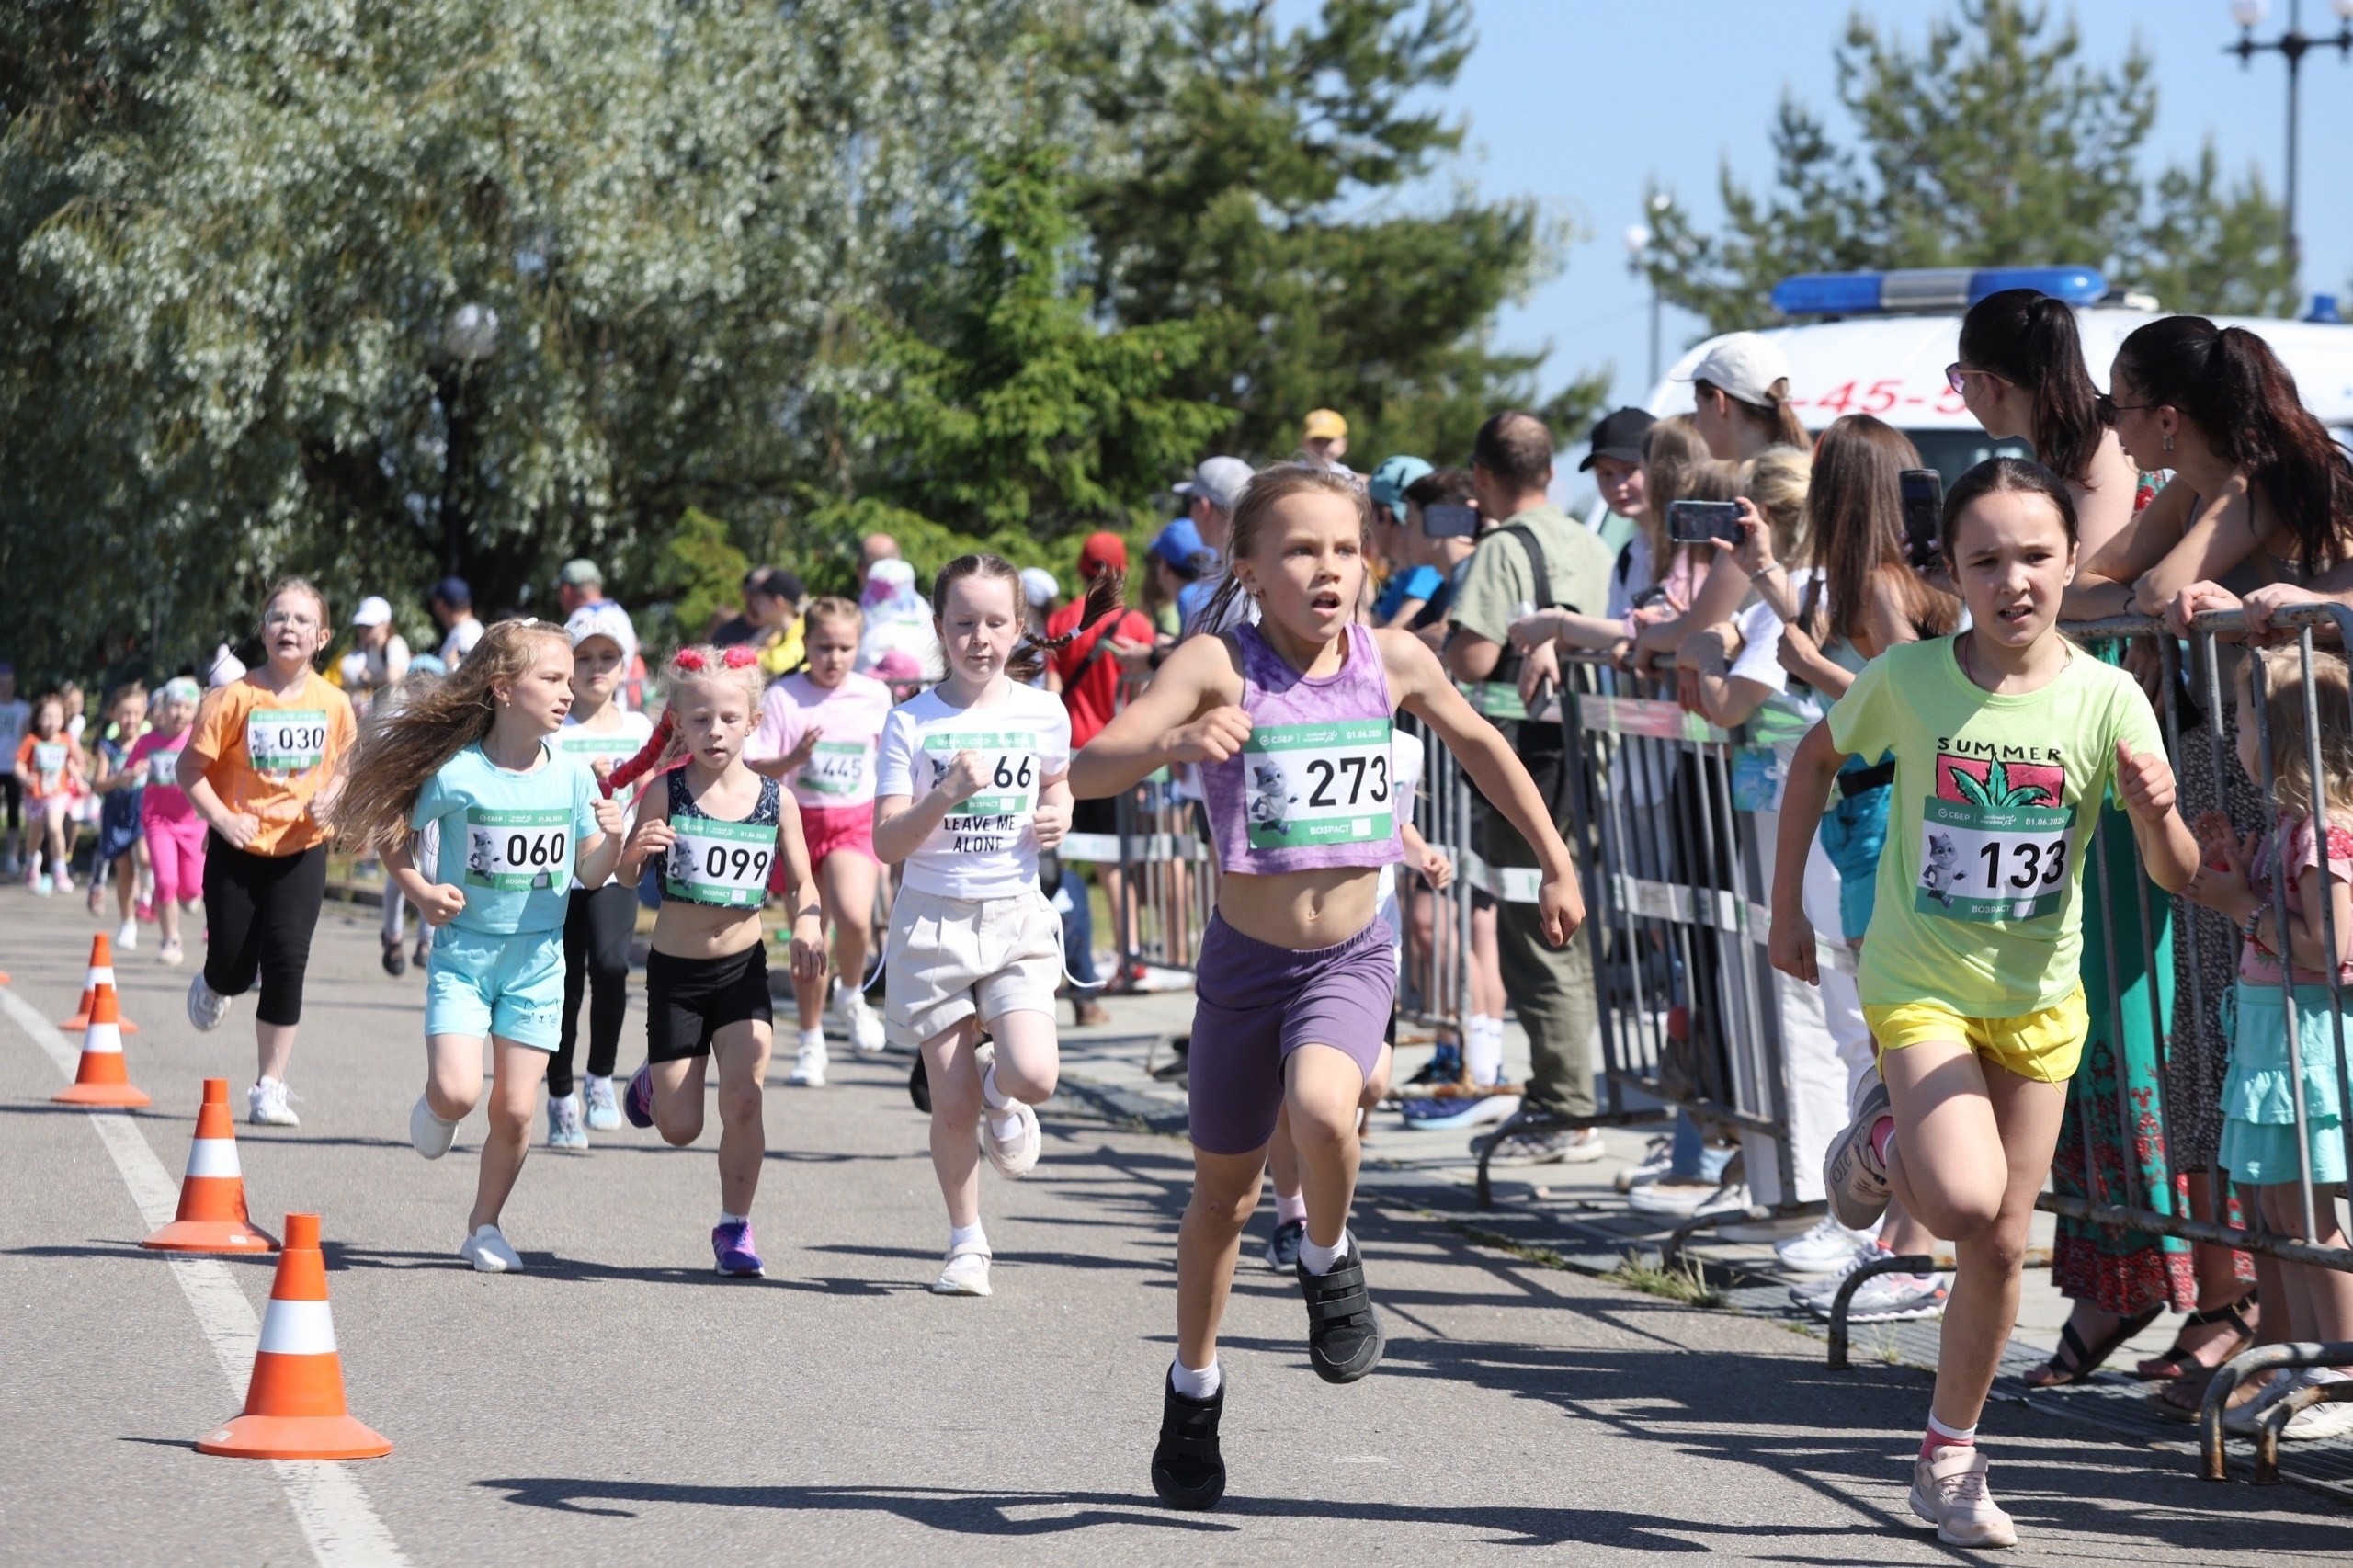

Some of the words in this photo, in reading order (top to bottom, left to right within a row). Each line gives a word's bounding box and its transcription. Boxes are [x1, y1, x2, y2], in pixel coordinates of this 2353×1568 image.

[279, 727, 324, 750] 030
[1270, 735, 1294, 744] СБЕР
[1938, 737, 2061, 761] SUMMER
[824, 757, 862, 779] 445
[993, 756, 1031, 788] 66
[1306, 755, 1388, 807] 273
[944, 816, 991, 831] LEAVE
[996, 814, 1016, 831] ME
[1949, 811, 1971, 821] СБЕР
[2026, 817, 2065, 825] 01.06.2024
[1310, 824, 1349, 835] ВОЗРАСТ
[507, 833, 565, 867] 060
[706, 846, 768, 881] 099
[1980, 839, 2067, 889] 133
[1972, 905, 2011, 914] ВОЗРАСТ
